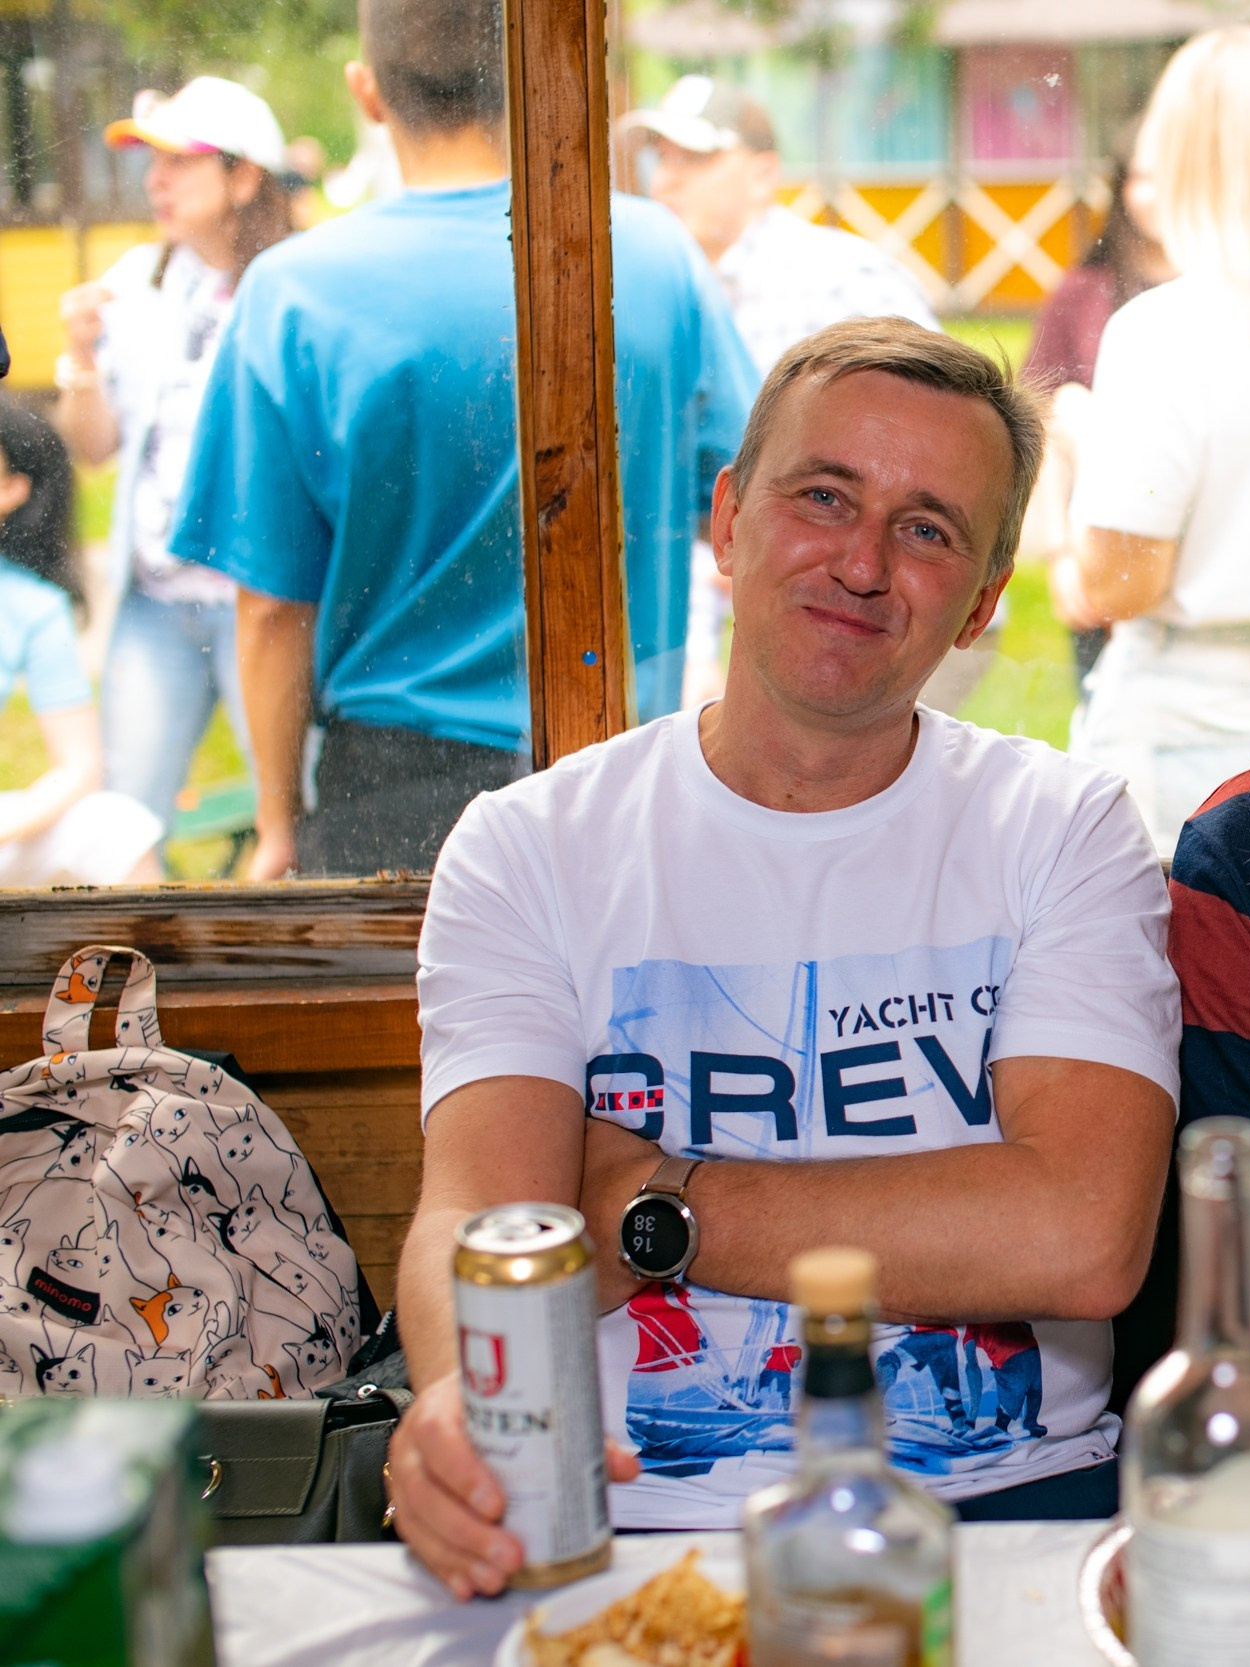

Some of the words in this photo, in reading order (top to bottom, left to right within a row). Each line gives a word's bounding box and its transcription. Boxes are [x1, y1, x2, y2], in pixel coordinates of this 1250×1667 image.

[828, 992, 954, 1037] YACHT
[634, 1214, 656, 1232] 38
[632, 1235, 654, 1253] 16
[34, 1278, 92, 1312] minomo
